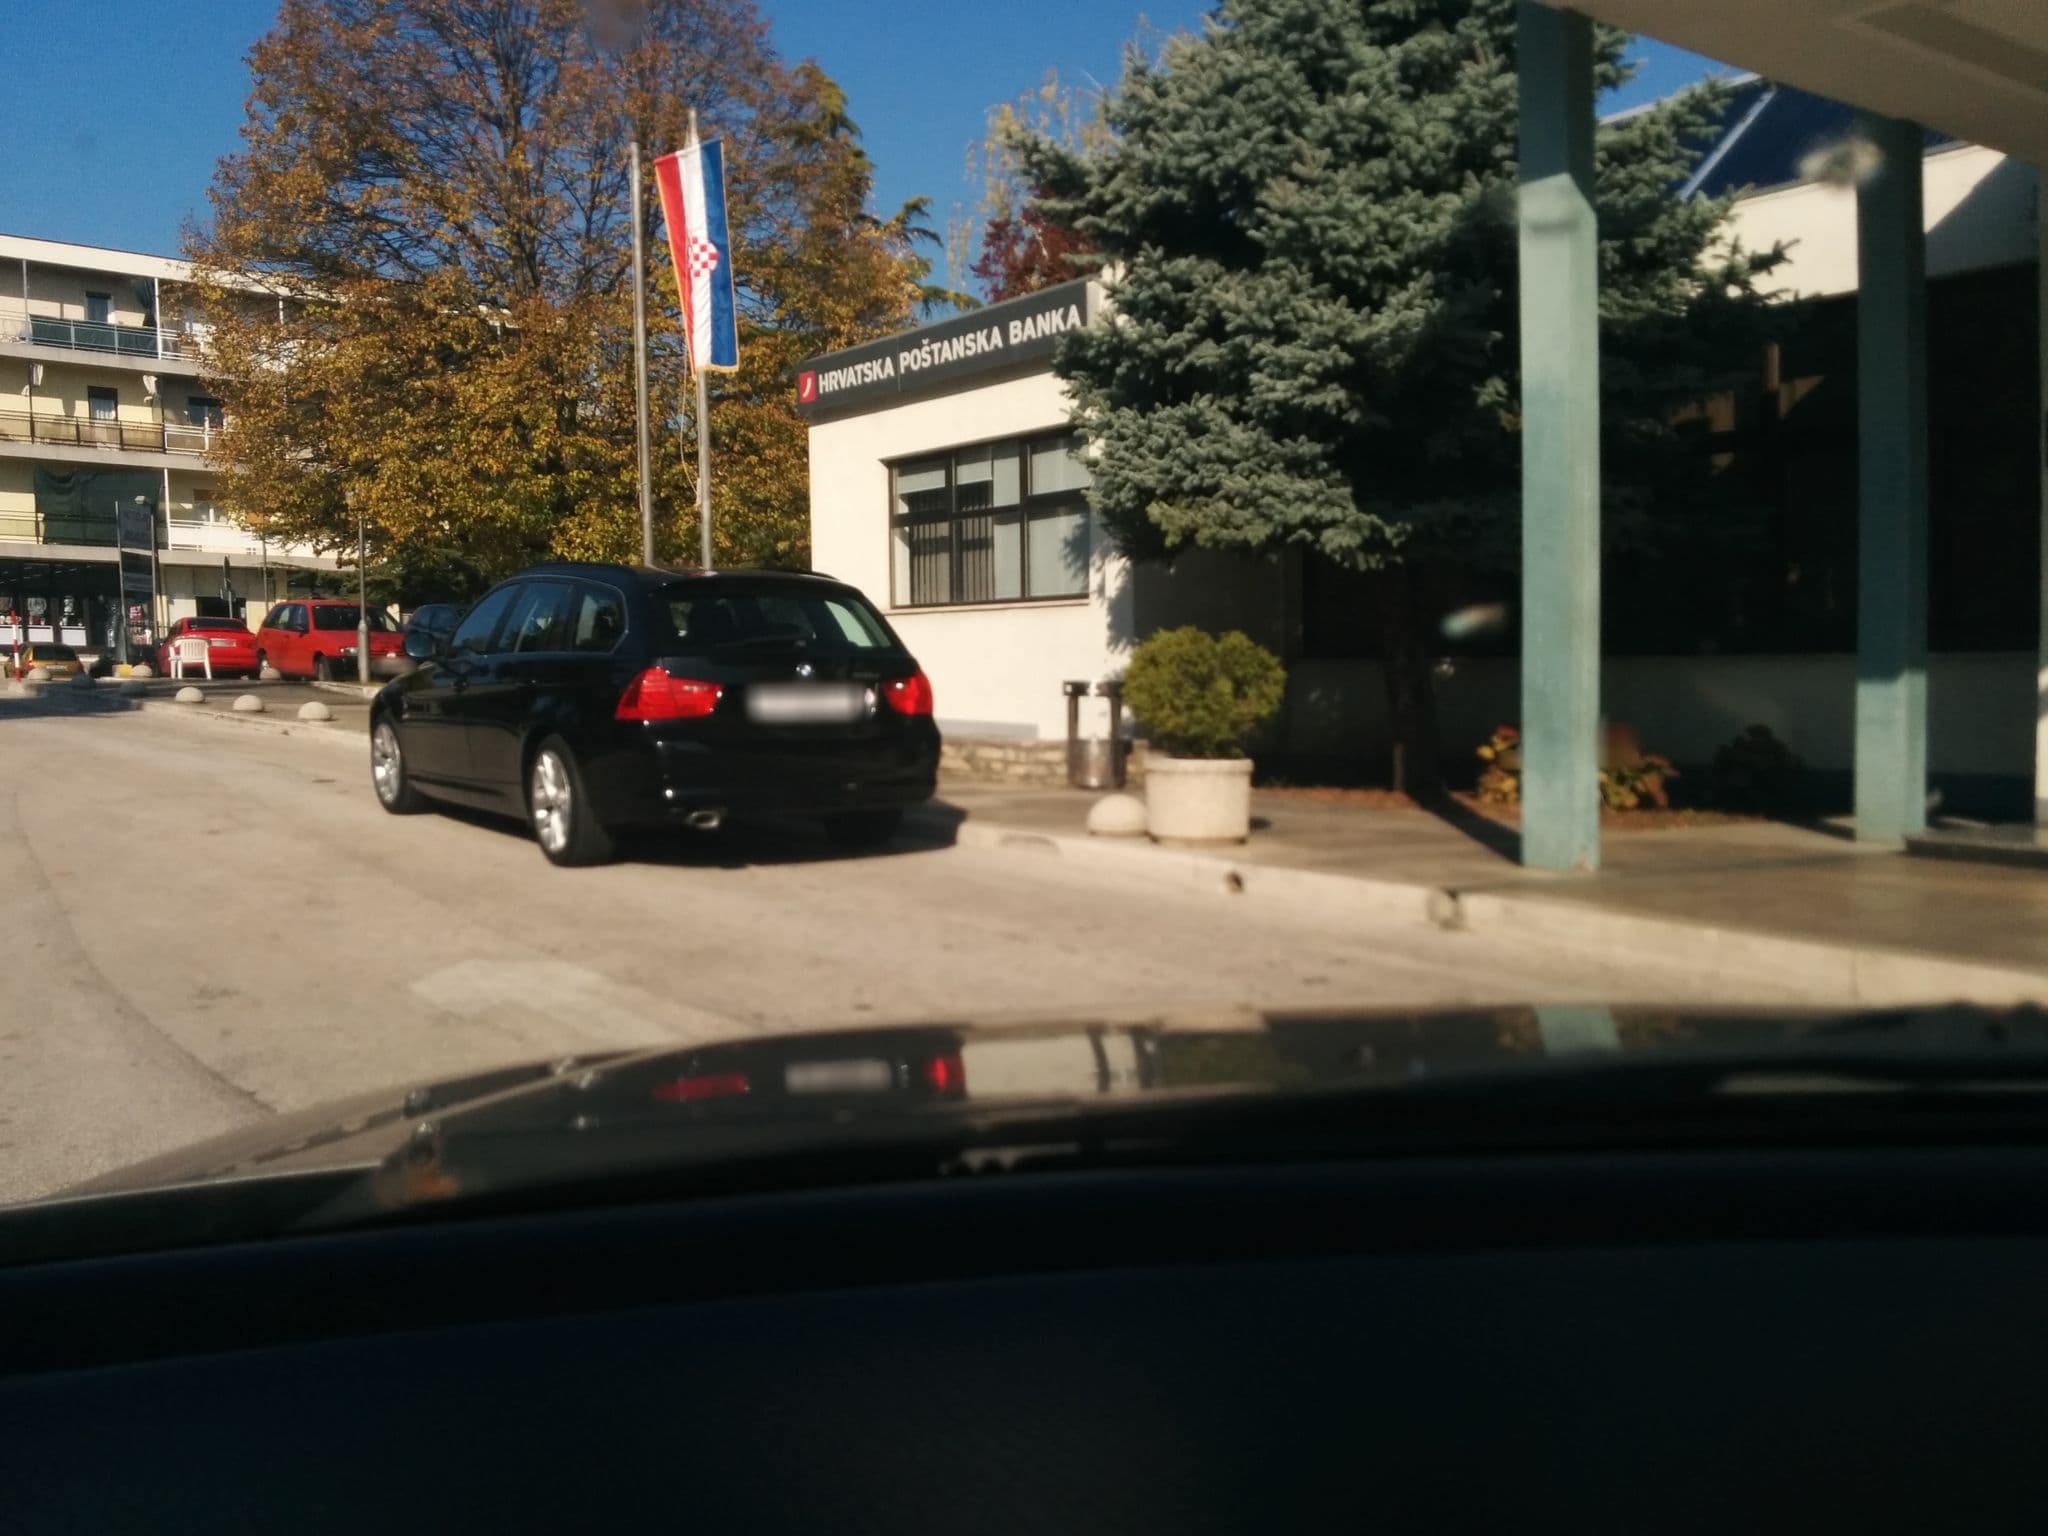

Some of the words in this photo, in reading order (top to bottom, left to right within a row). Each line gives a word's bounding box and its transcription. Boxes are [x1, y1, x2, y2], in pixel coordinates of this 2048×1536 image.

[818, 356, 894, 394] HRVATSKA
[899, 325, 1003, 374] POŠTANSKA
[1009, 303, 1082, 345] BANKA
